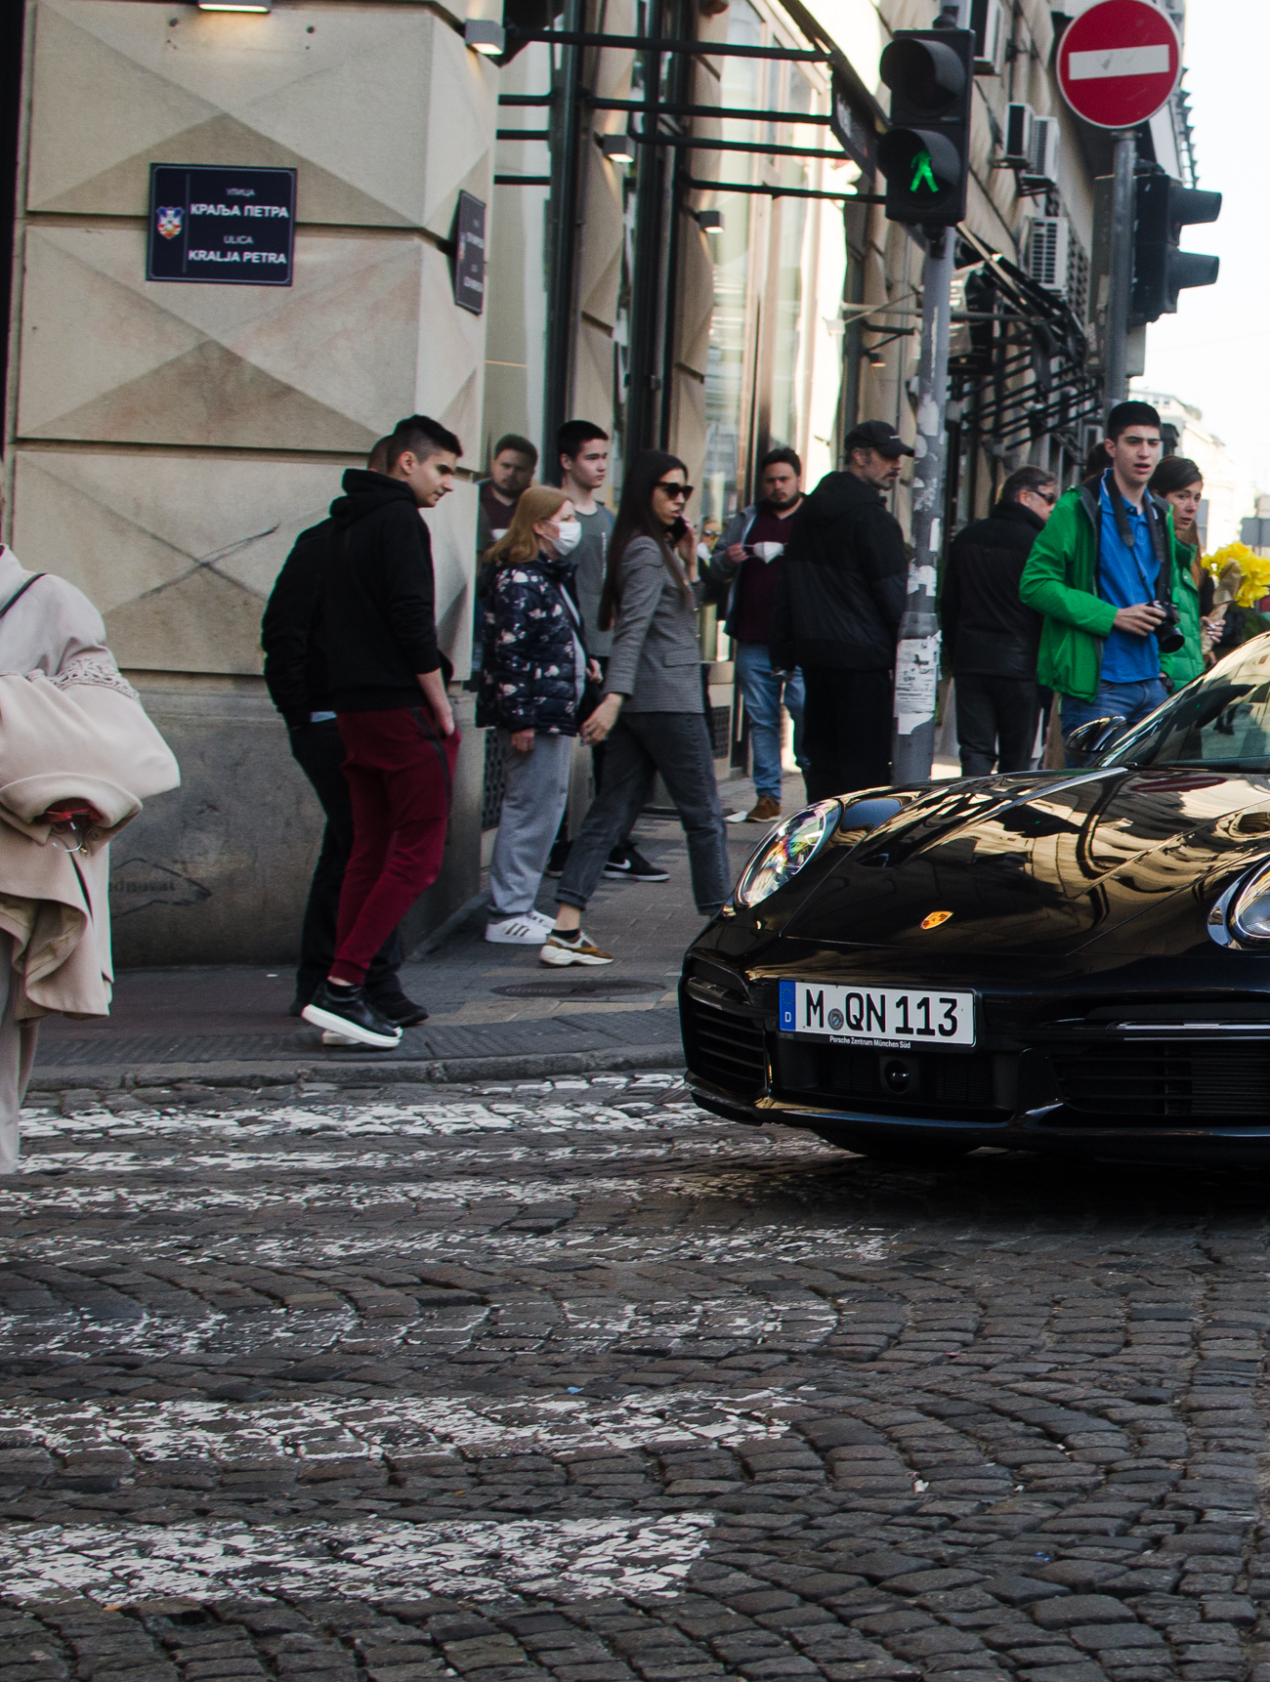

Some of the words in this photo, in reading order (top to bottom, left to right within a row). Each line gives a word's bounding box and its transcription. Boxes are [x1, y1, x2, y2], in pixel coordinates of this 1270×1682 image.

[190, 203, 241, 216] КРАЉА
[244, 205, 289, 218] ПЕТРА
[223, 235, 254, 244] ULICA
[188, 250, 240, 262] KRALJA
[243, 252, 287, 264] PETRA
[784, 1011, 792, 1023] D
[806, 989, 825, 1028] M
[845, 992, 886, 1033] QN
[895, 995, 958, 1037] 113
[829, 1035, 850, 1044] Porsche
[851, 1037, 873, 1046] Zentrum
[873, 1039, 899, 1048] München
[900, 1041, 911, 1049] Süd
